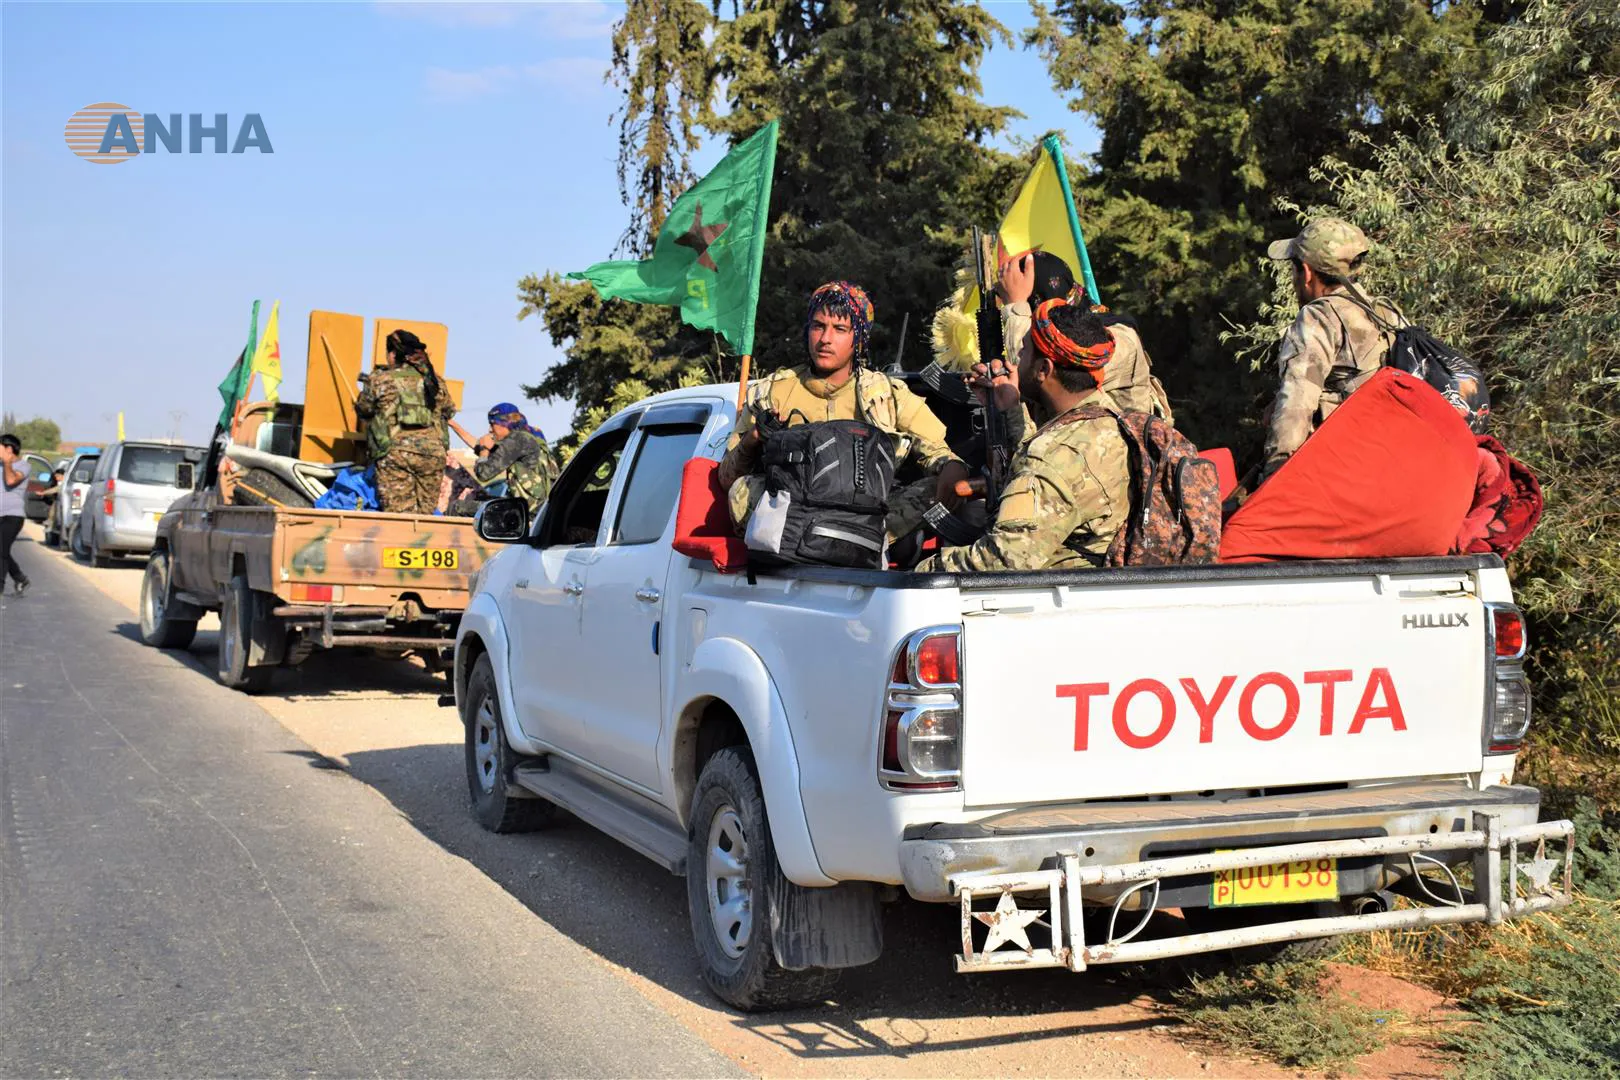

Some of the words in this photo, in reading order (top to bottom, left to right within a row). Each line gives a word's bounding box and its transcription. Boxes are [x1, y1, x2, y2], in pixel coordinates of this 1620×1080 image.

[399, 550, 454, 567] S-198
[1402, 612, 1469, 629] HILUX
[1056, 668, 1408, 751] TOYOTA
[1238, 858, 1332, 890] 00138
